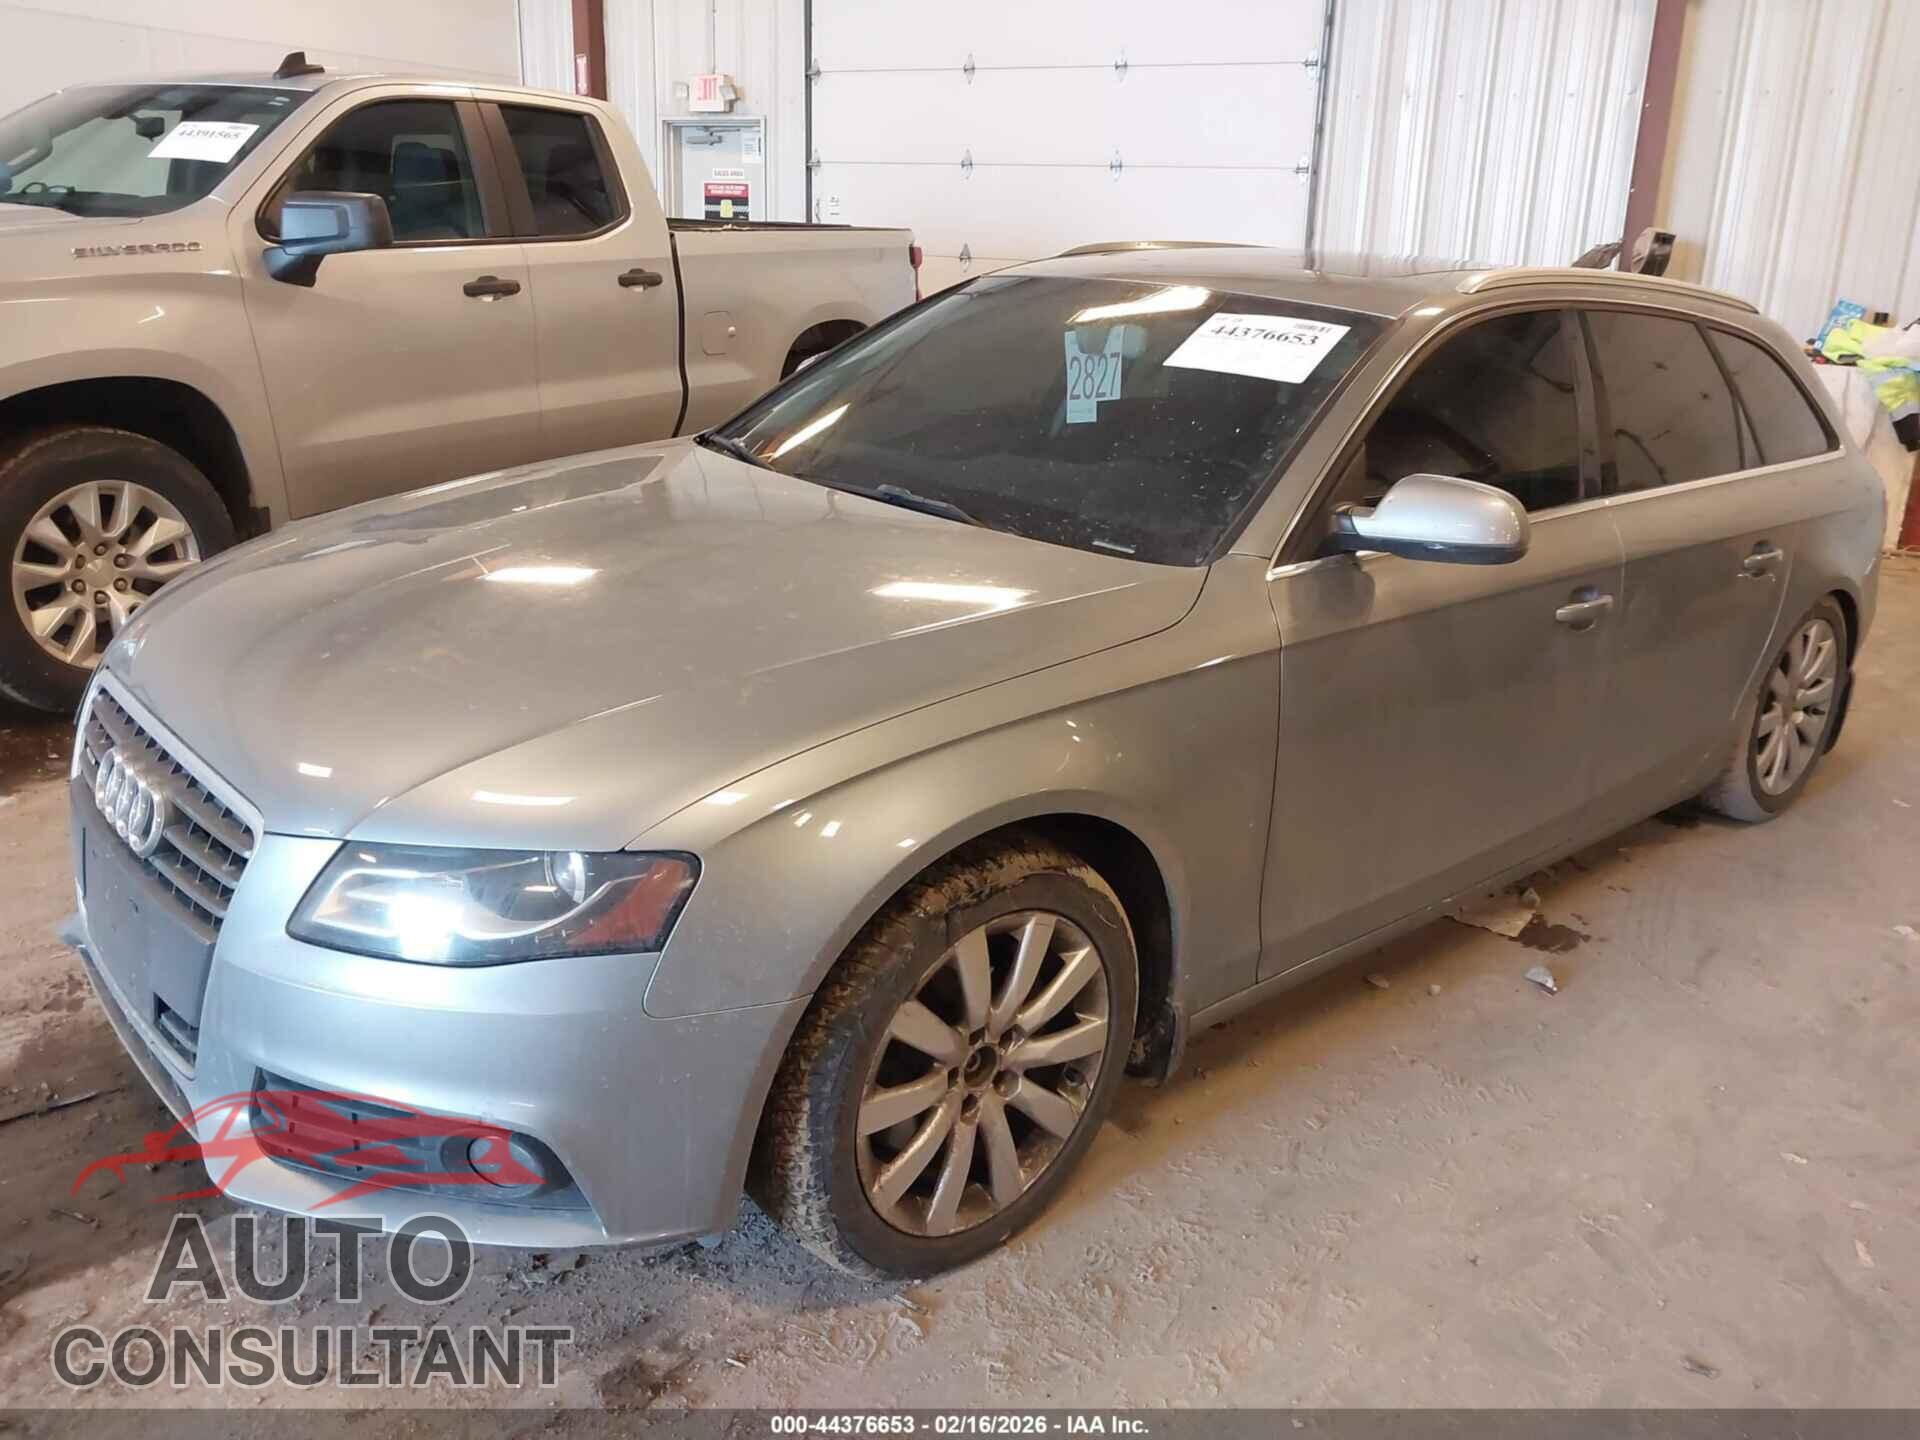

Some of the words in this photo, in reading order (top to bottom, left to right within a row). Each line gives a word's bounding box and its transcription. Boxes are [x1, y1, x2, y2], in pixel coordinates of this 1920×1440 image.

[72, 241, 202, 259] SILVERADO
[1210, 324, 1319, 346] 44376653
[1070, 352, 1120, 400] 2827
